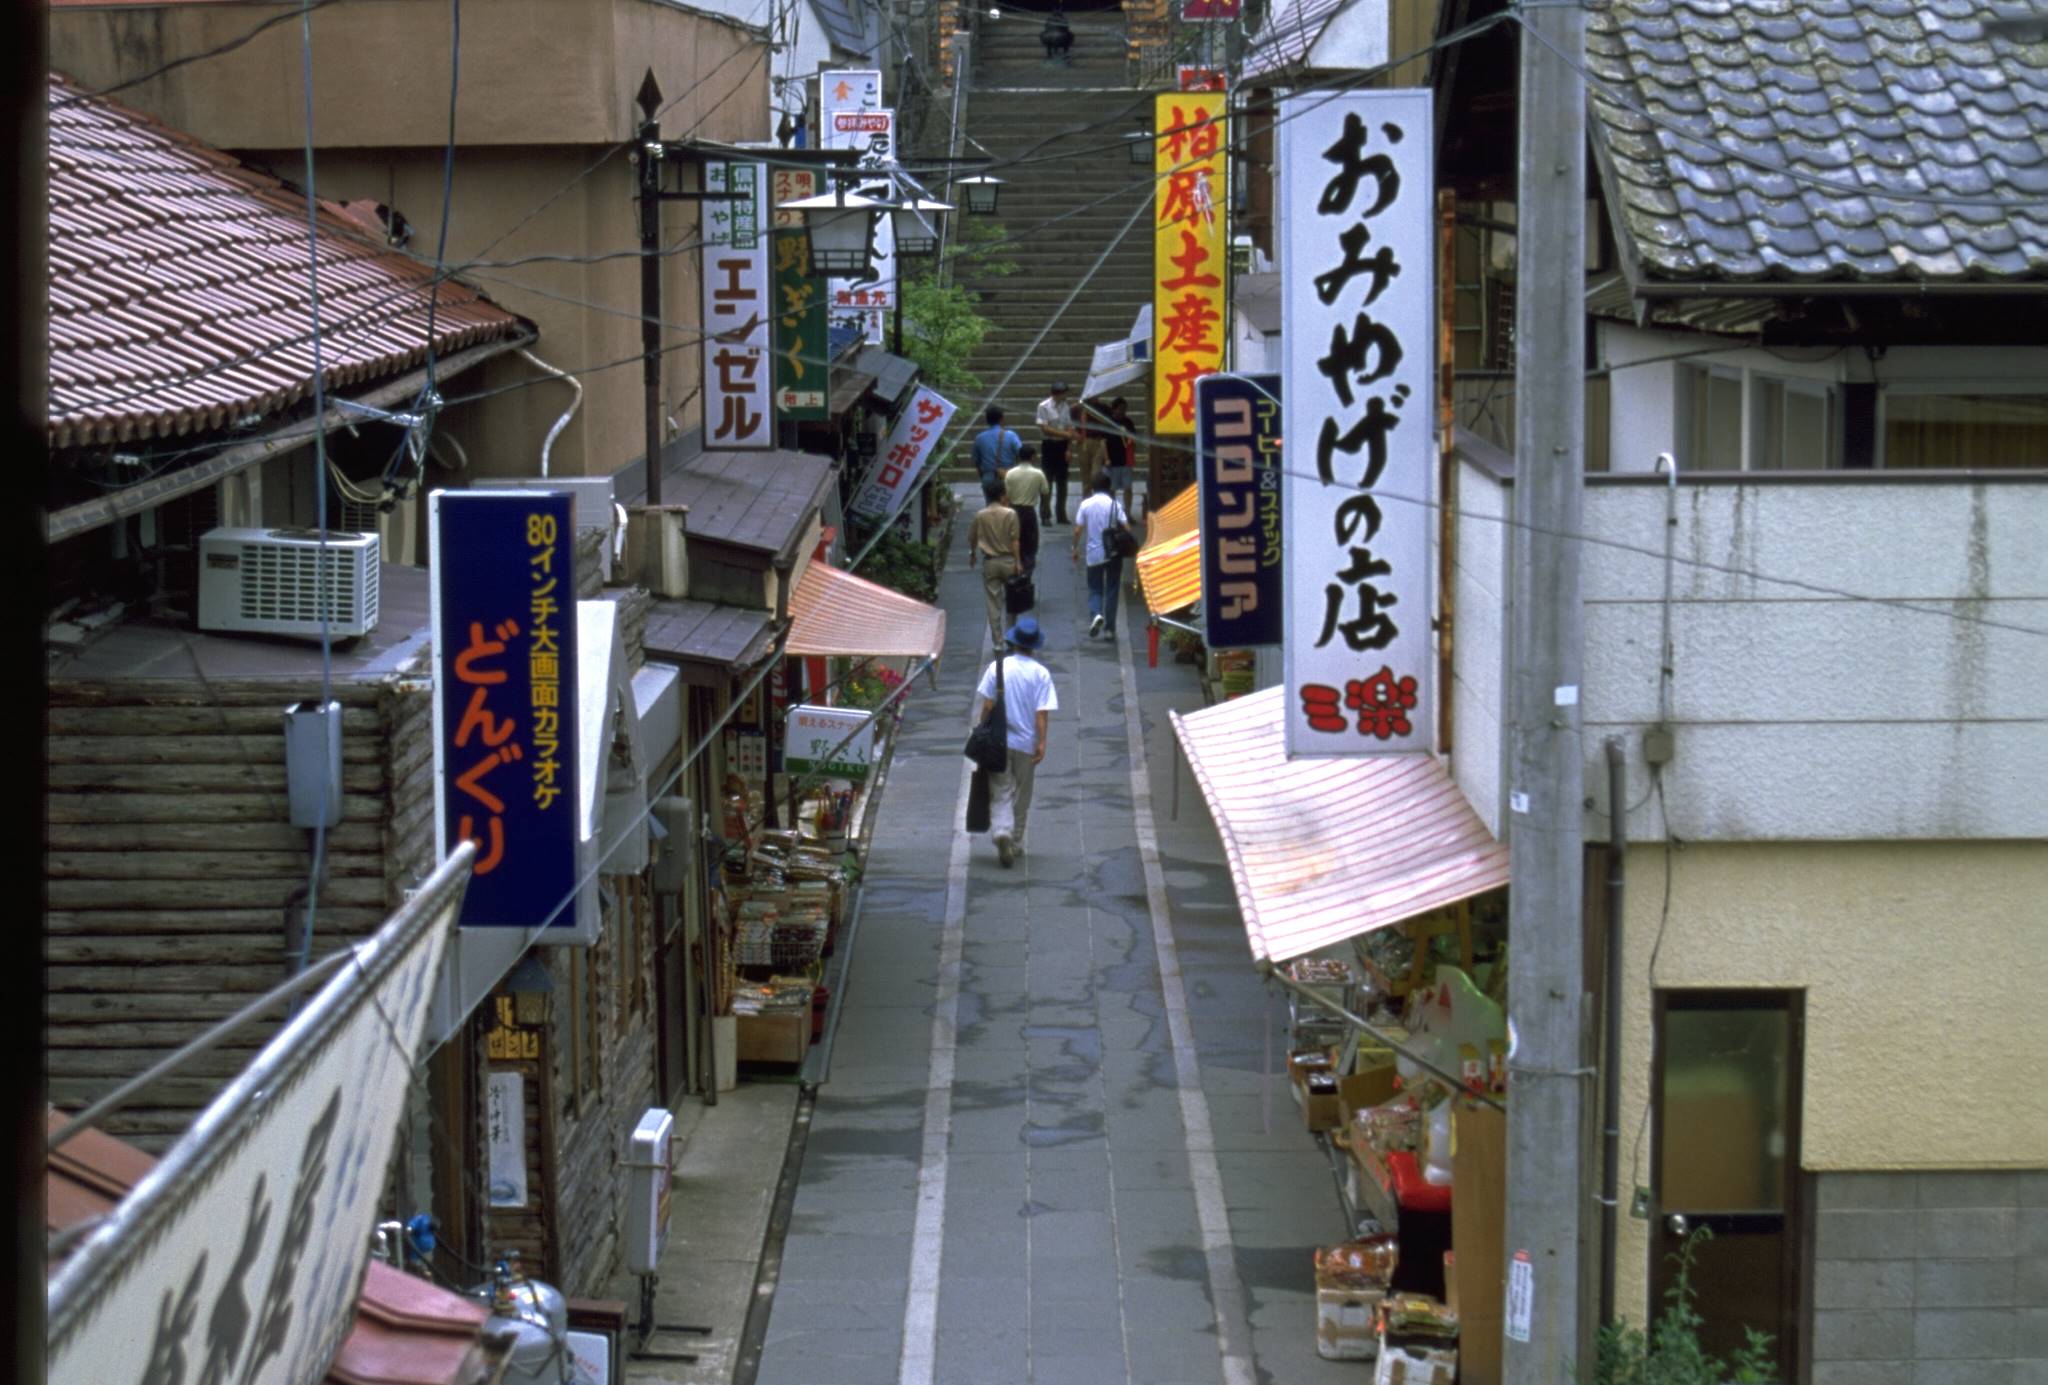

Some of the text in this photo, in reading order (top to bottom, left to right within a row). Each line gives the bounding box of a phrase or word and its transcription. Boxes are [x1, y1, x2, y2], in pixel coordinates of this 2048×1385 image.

[777, 171, 793, 225] スナク
[712, 258, 763, 440] エンゼル
[1314, 112, 1411, 652] おみやげの店
[1213, 397, 1259, 621] コロンビア
[1256, 399, 1281, 567] コーヒー&スナック
[454, 618, 524, 876] どんぐり
[526, 513, 562, 811] 80インチ大画面カラオケ
